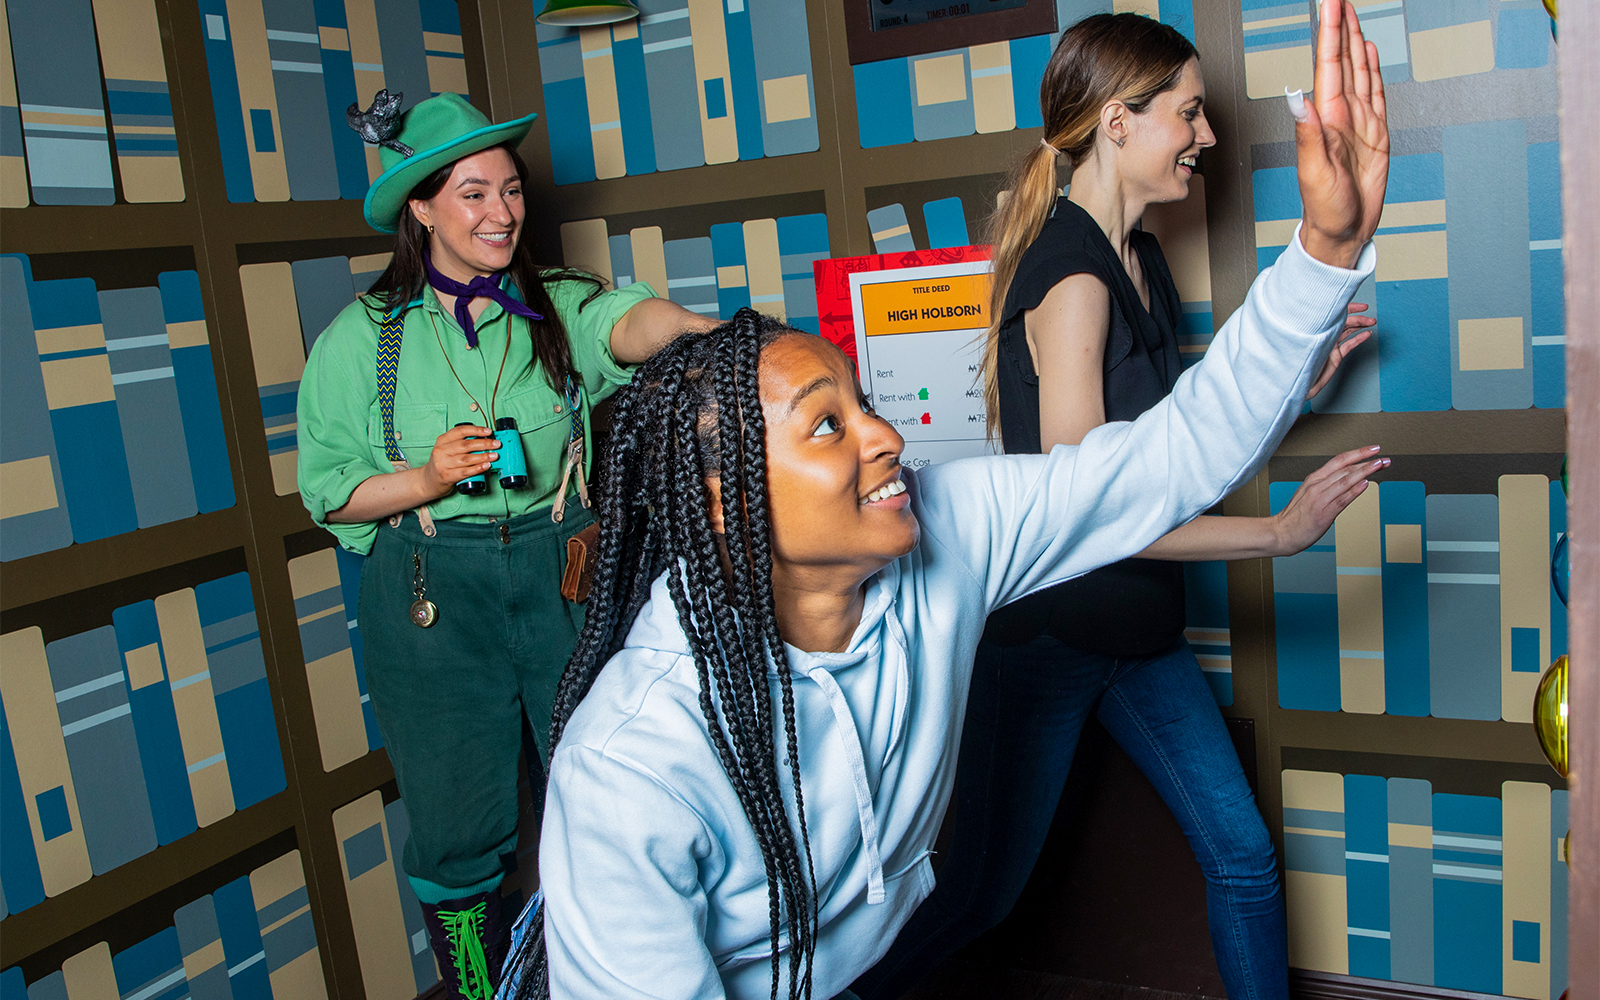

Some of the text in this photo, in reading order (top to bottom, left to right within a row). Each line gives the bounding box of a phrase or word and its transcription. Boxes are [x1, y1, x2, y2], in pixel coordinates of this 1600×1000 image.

[880, 17, 903, 28] ROUND:
[913, 285, 950, 294] TITLE DEED
[888, 304, 981, 322] HIGH HOLBORN
[877, 370, 894, 378] Rent
[879, 392, 916, 402] Rent with
[900, 417, 919, 426] with
[913, 458, 931, 467] Cost
